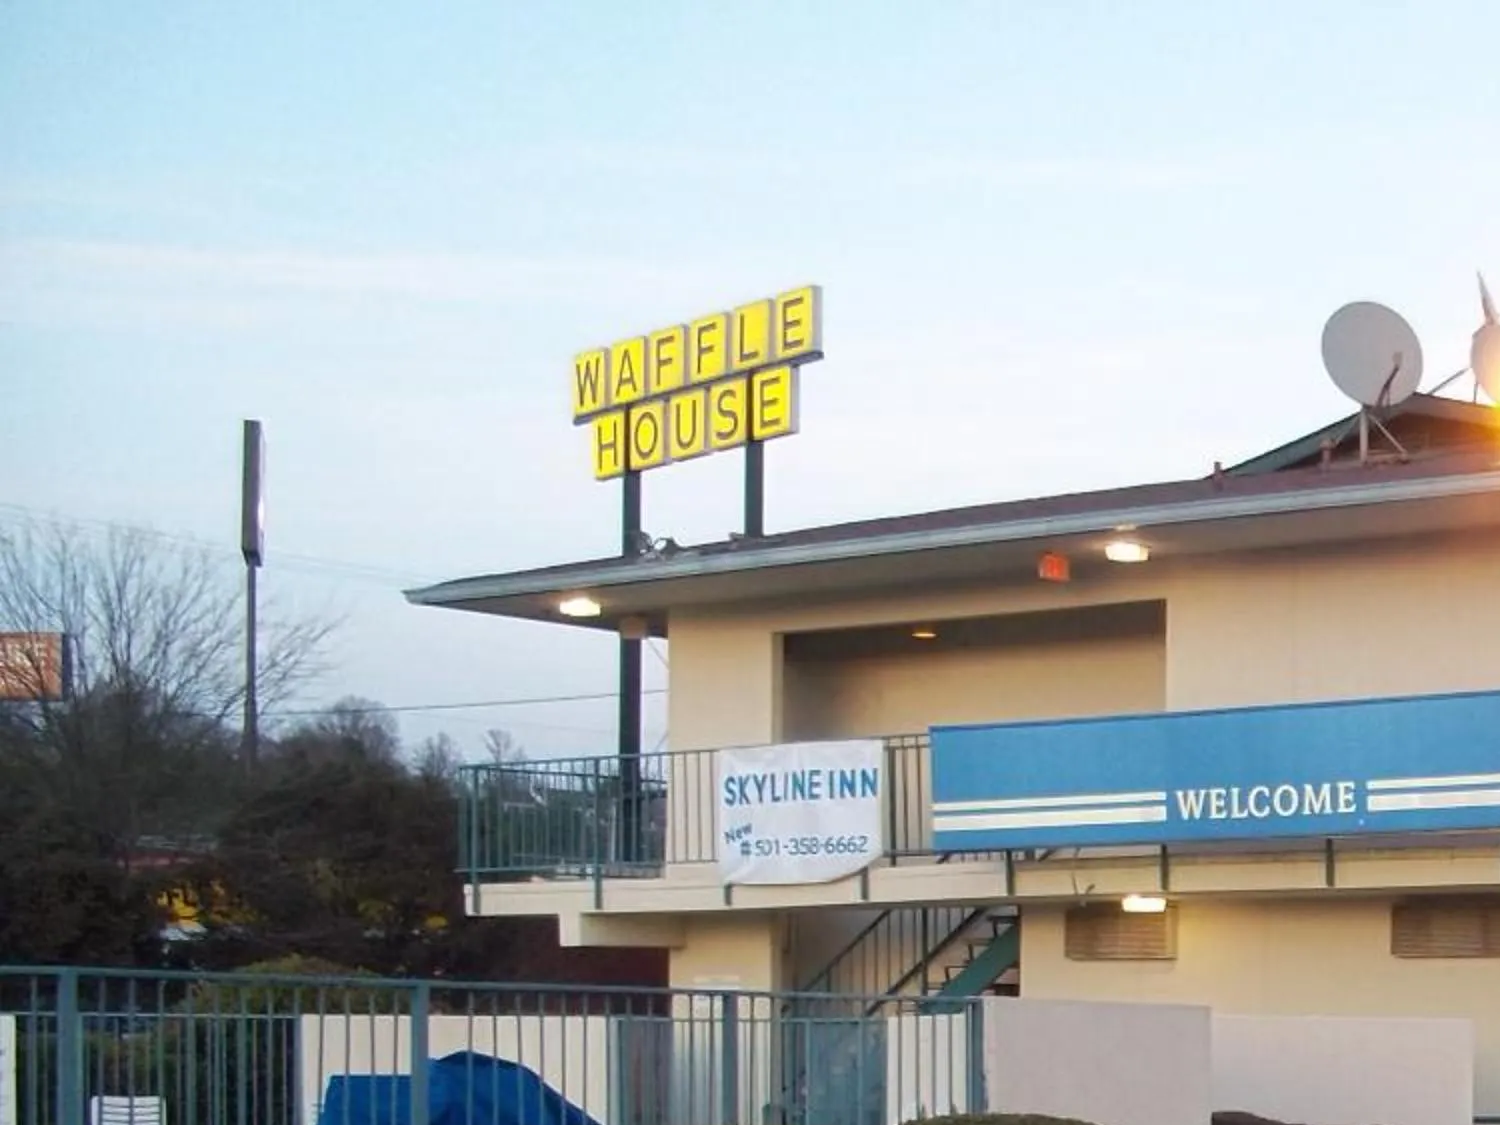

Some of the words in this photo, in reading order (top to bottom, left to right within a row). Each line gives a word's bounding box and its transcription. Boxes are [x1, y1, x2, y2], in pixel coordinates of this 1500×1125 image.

[575, 296, 805, 408] WAFFLE
[597, 375, 781, 472] HOUSE
[724, 769, 822, 807] SKYLINE
[828, 768, 879, 800] INN
[1175, 781, 1357, 820] WELCOME
[724, 823, 753, 844] New
